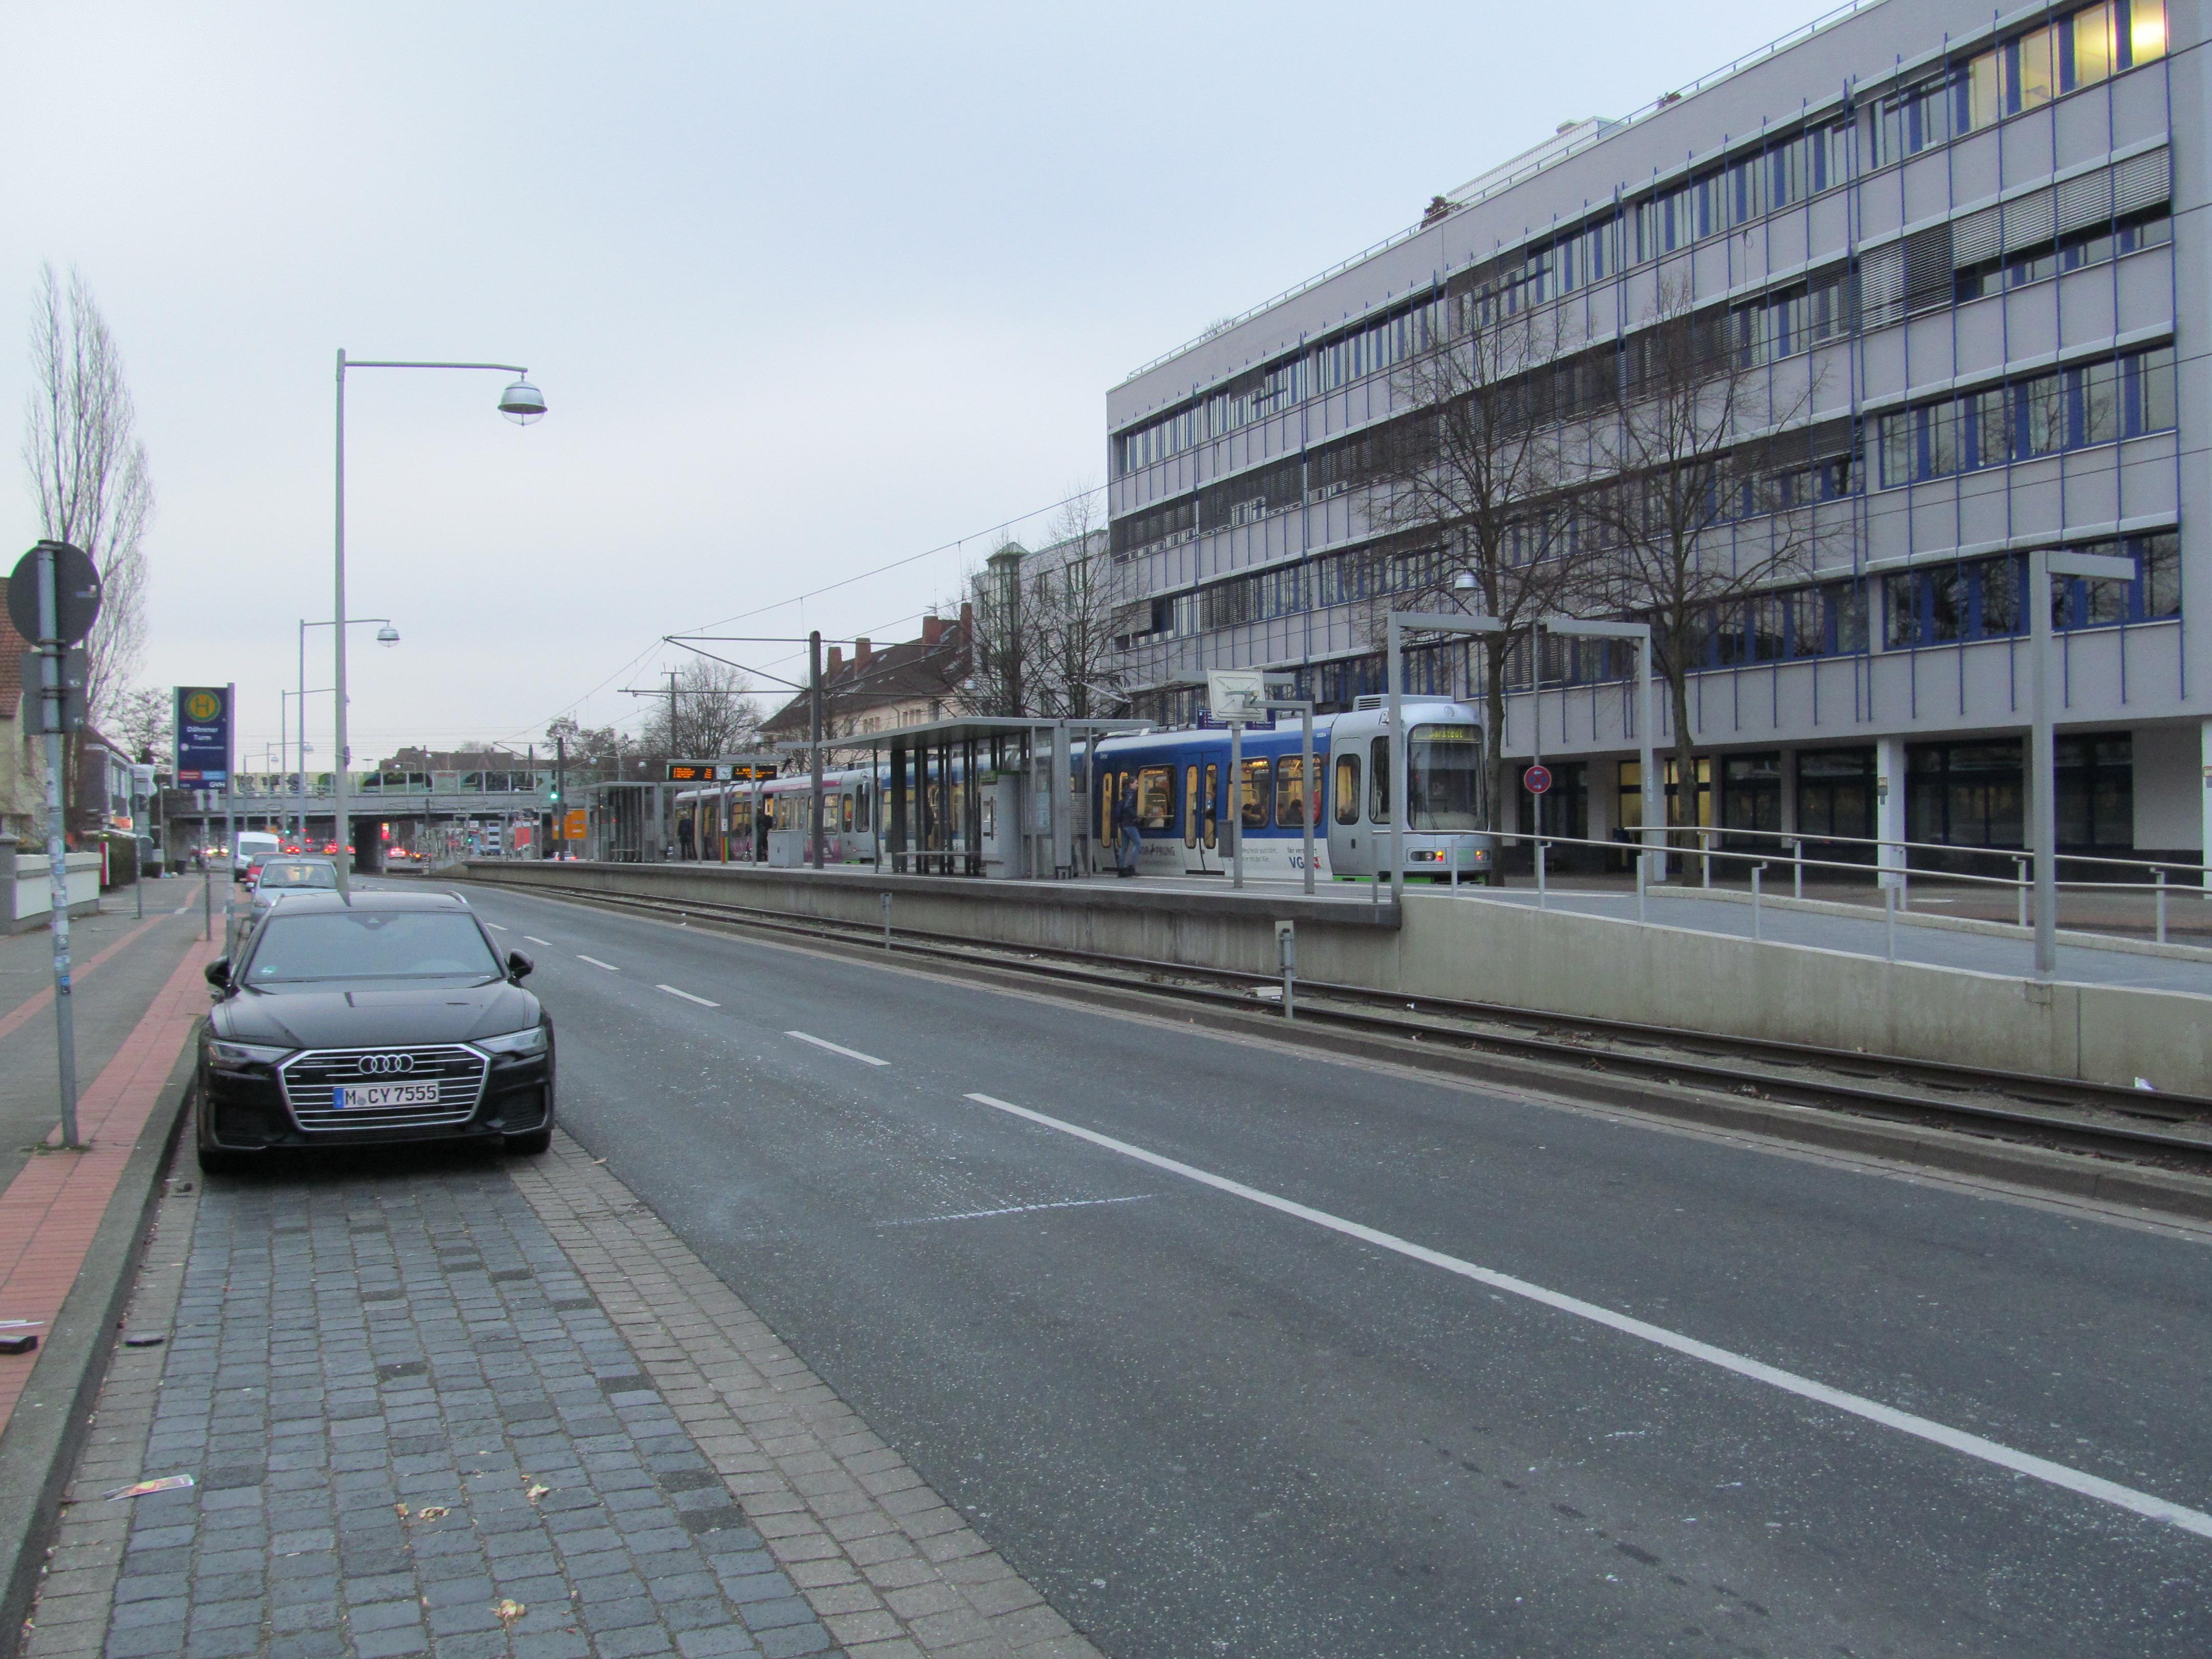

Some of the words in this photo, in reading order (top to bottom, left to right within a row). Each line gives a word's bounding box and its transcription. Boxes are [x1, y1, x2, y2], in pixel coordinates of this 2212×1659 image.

[196, 698, 209, 714] H
[345, 1090, 356, 1105] M
[368, 1088, 390, 1104] CY
[394, 1085, 436, 1102] 7555
